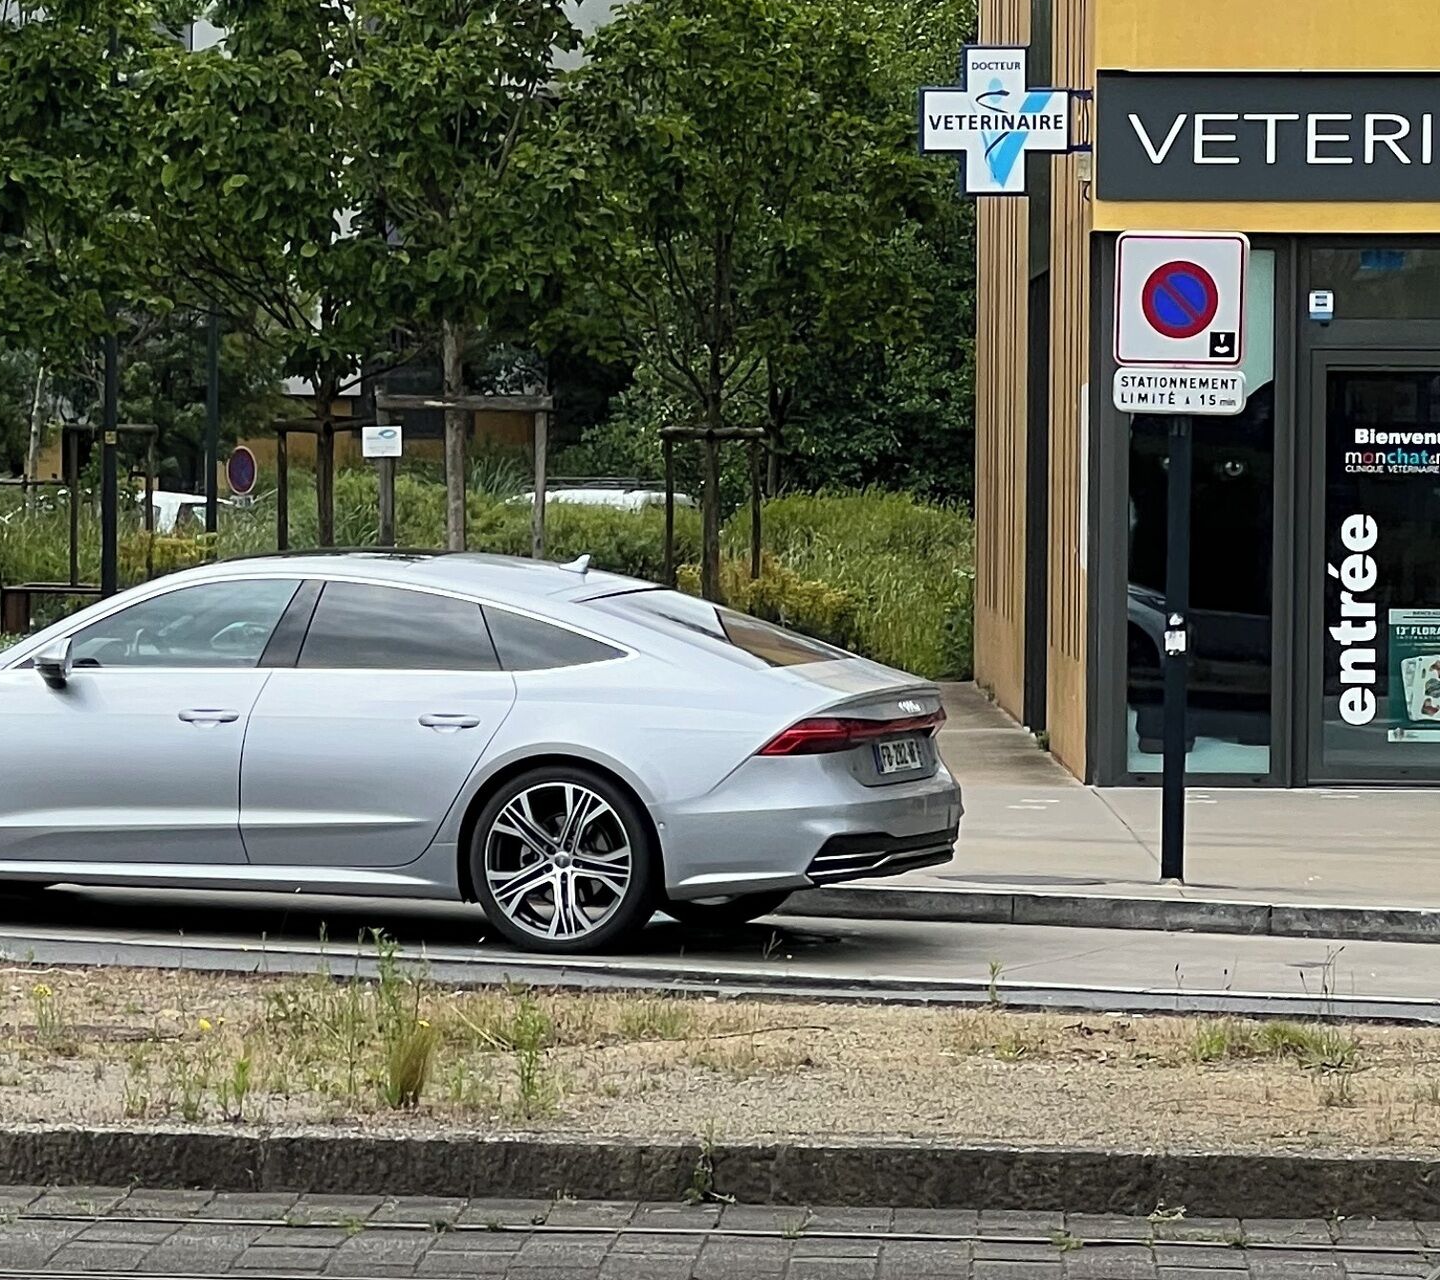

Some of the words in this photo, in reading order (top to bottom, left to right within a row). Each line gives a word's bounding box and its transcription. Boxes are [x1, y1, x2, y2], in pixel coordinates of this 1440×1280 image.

[971, 61, 1021, 70] DOCTEUR
[928, 114, 1064, 131] VETERINAIRE
[1127, 113, 1433, 165] VETERI
[1121, 376, 1237, 389] STATIONNEMENT
[1121, 391, 1176, 405] LIMITÉ
[1200, 394, 1216, 405] 15
[1345, 465, 1384, 473] CLINIQUE
[1328, 514, 1377, 724] entrée
